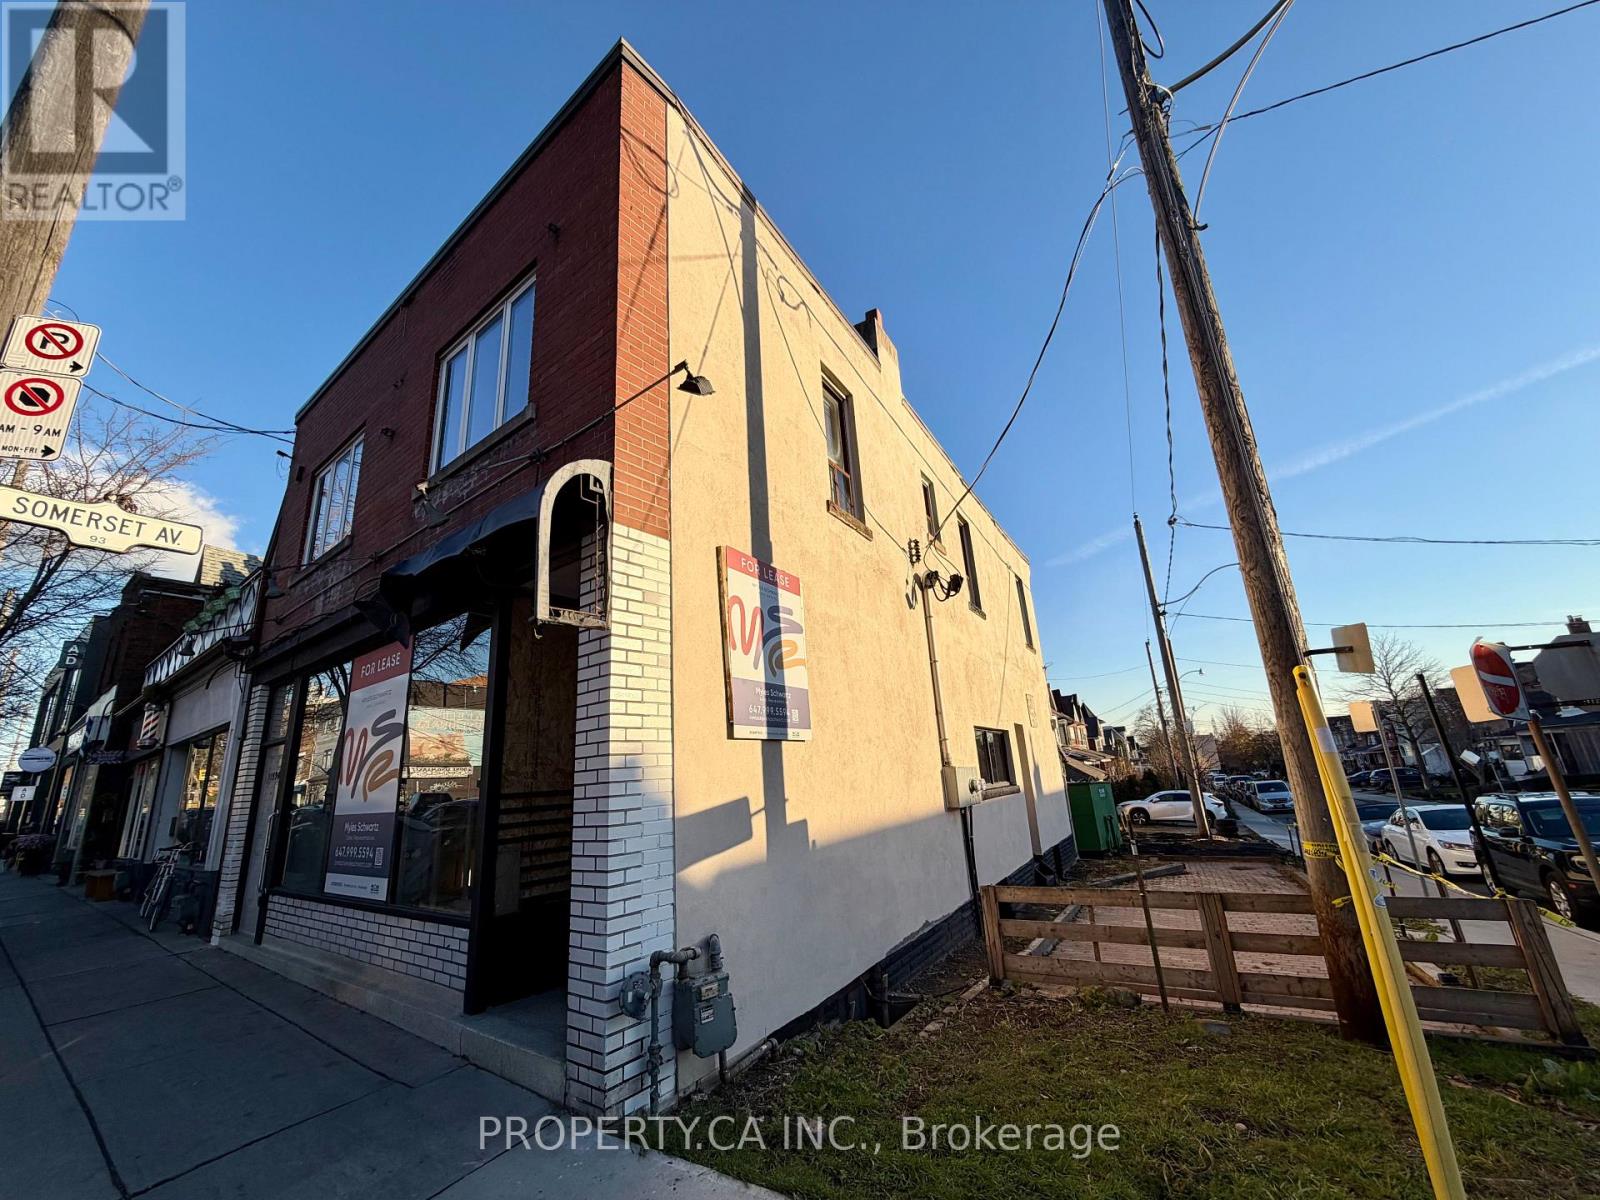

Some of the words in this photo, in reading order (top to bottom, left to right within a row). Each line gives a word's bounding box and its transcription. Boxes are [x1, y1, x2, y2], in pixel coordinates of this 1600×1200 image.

[1, 445, 38, 454] MON-FRI
[12, 496, 147, 537] SOMERSET
[89, 535, 106, 545] 93
[741, 557, 760, 576] FOR
[763, 567, 790, 588] LEASE
[360, 662, 376, 678] FOR
[377, 652, 401, 672] LEASE
